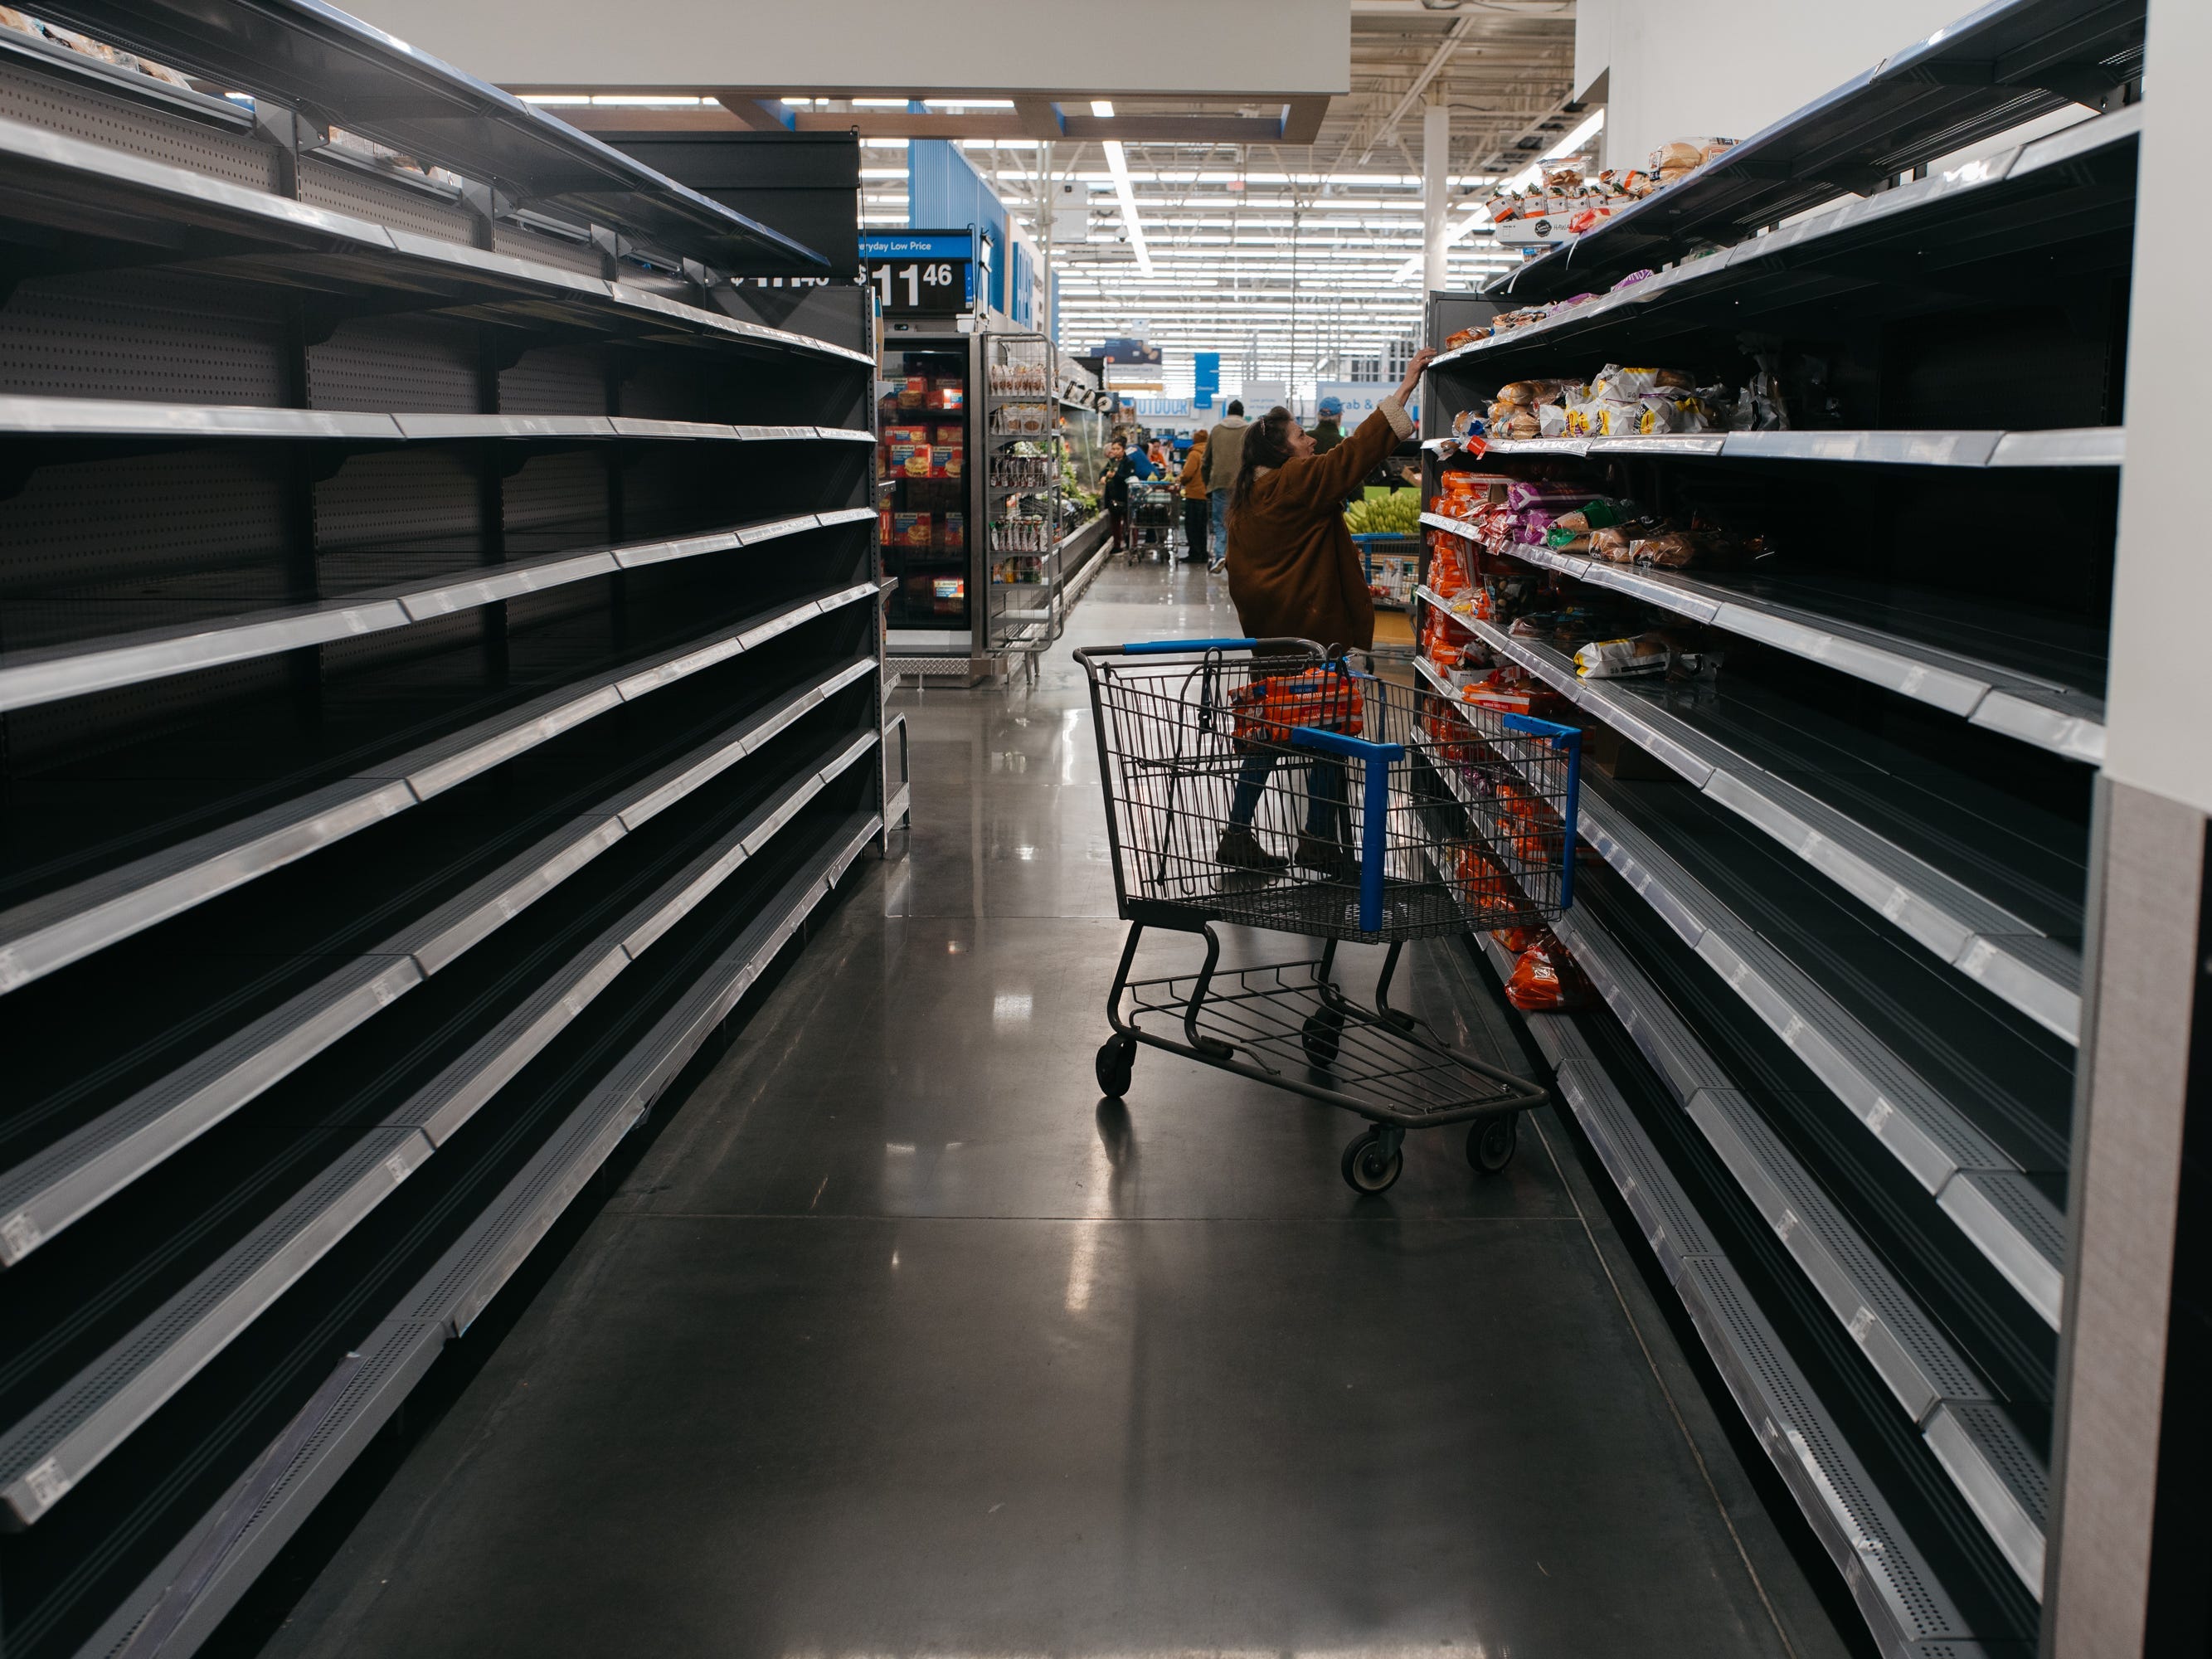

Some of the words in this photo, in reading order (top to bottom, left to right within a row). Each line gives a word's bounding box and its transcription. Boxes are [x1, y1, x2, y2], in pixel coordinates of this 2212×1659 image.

[858, 241, 889, 252] eryday
[891, 241, 908, 251] Low
[910, 241, 932, 251] Price
[1138, 398, 1188, 415] UTDOOR
[1342, 399, 1361, 410] rab
[1364, 399, 1373, 411] &
